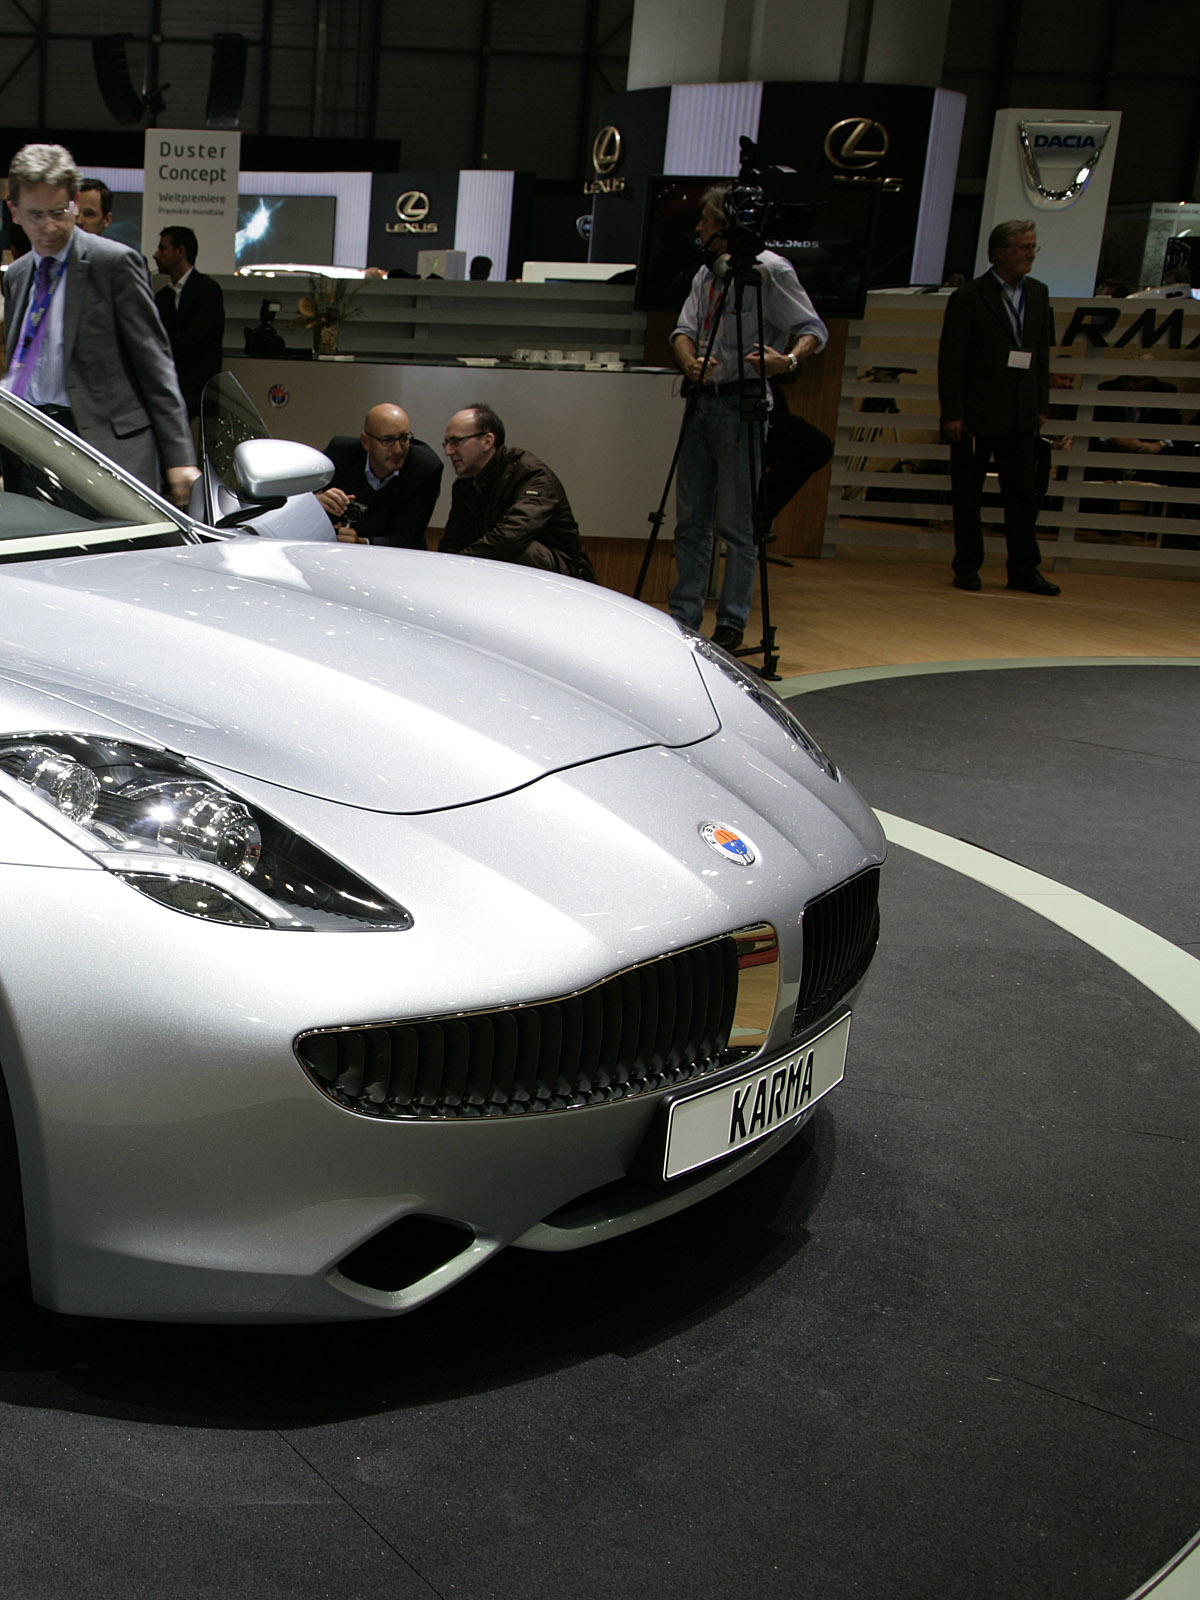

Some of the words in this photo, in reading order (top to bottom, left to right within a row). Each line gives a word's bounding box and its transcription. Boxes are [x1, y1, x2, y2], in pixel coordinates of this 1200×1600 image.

[159, 141, 227, 159] Duster
[1034, 135, 1096, 149] DACIA
[159, 164, 227, 185] Concept
[583, 177, 626, 195] LEXUS
[159, 192, 227, 204] Weltpremiere
[385, 222, 439, 234] LEXUS
[728, 1049, 815, 1144] KARMA
